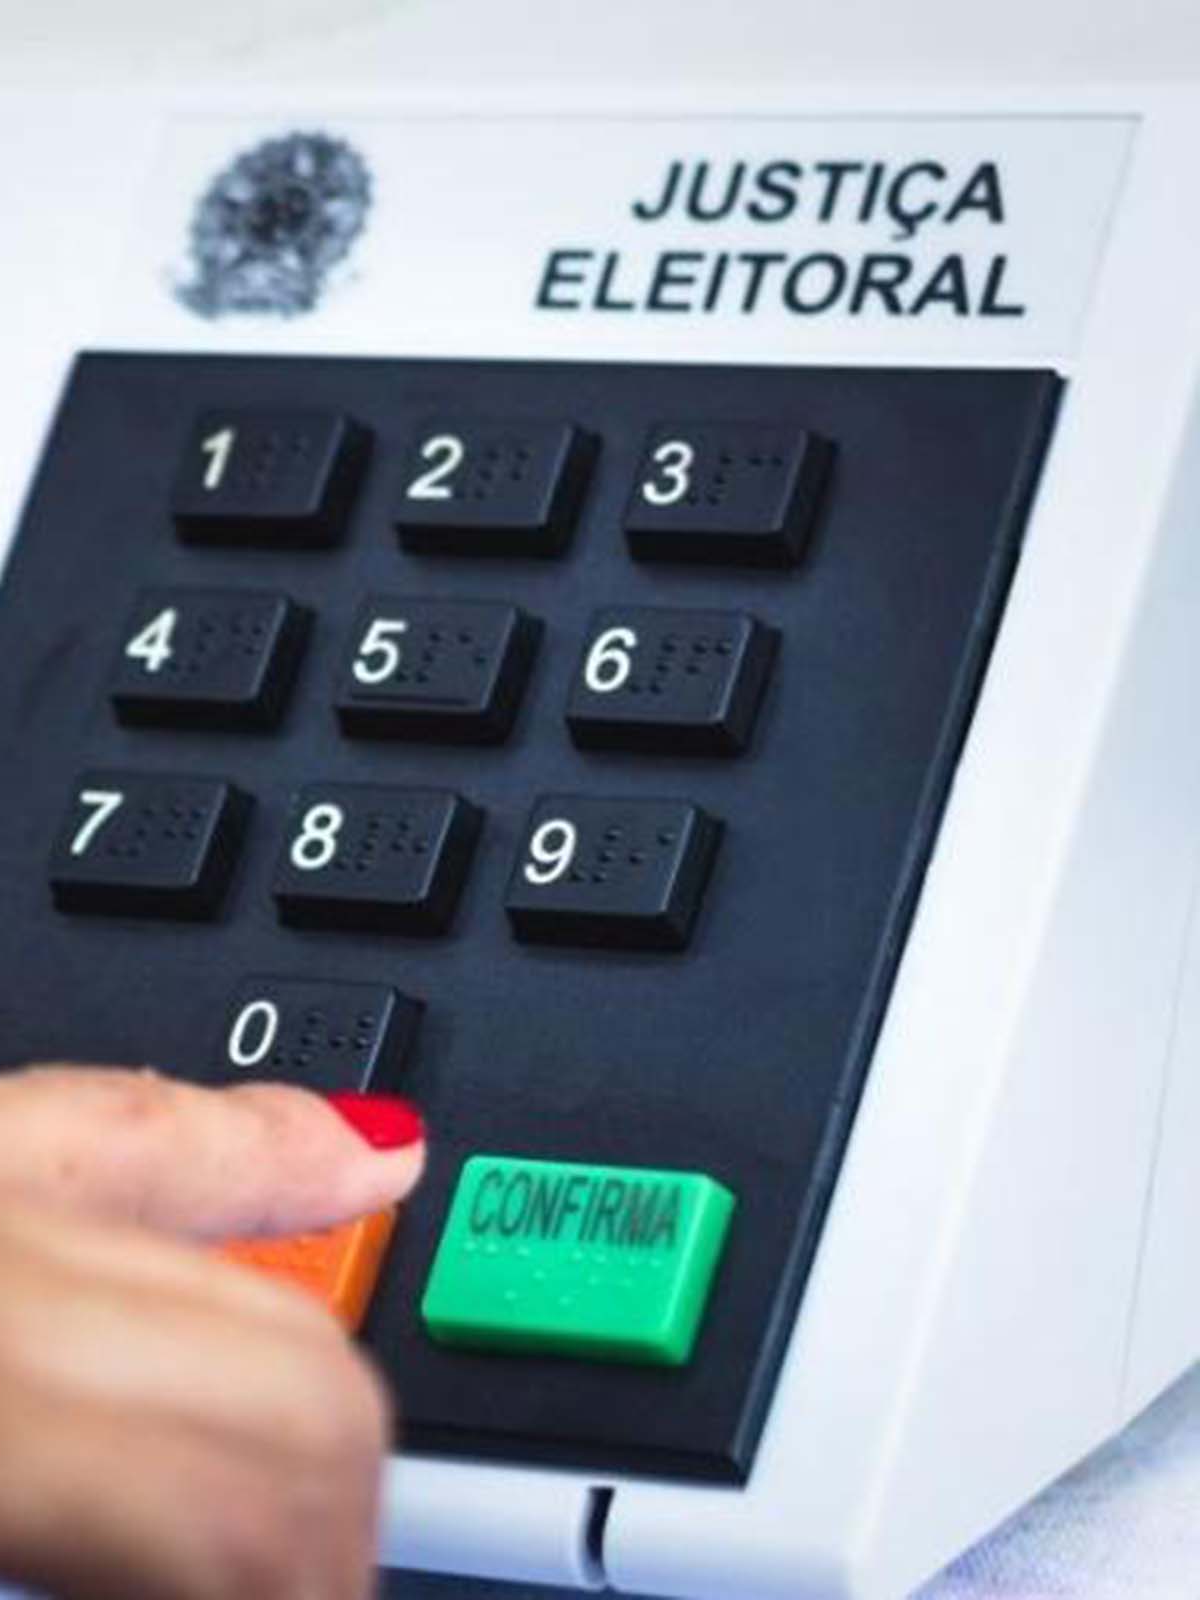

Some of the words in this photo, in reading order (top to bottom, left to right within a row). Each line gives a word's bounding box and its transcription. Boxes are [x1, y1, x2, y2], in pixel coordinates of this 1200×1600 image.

[630, 160, 1007, 241] JUSTIÇA
[534, 249, 1027, 317] ELEITORAL
[202, 428, 235, 490] 1
[406, 434, 465, 500] 2
[641, 440, 695, 506] 3
[124, 607, 178, 673] 4
[351, 617, 408, 684] 5
[583, 627, 639, 694] 6
[69, 789, 123, 855] 7
[289, 803, 345, 871] 8
[523, 818, 577, 885] 9
[227, 1000, 280, 1066] 0
[468, 1169, 682, 1249] CONFIRMA
